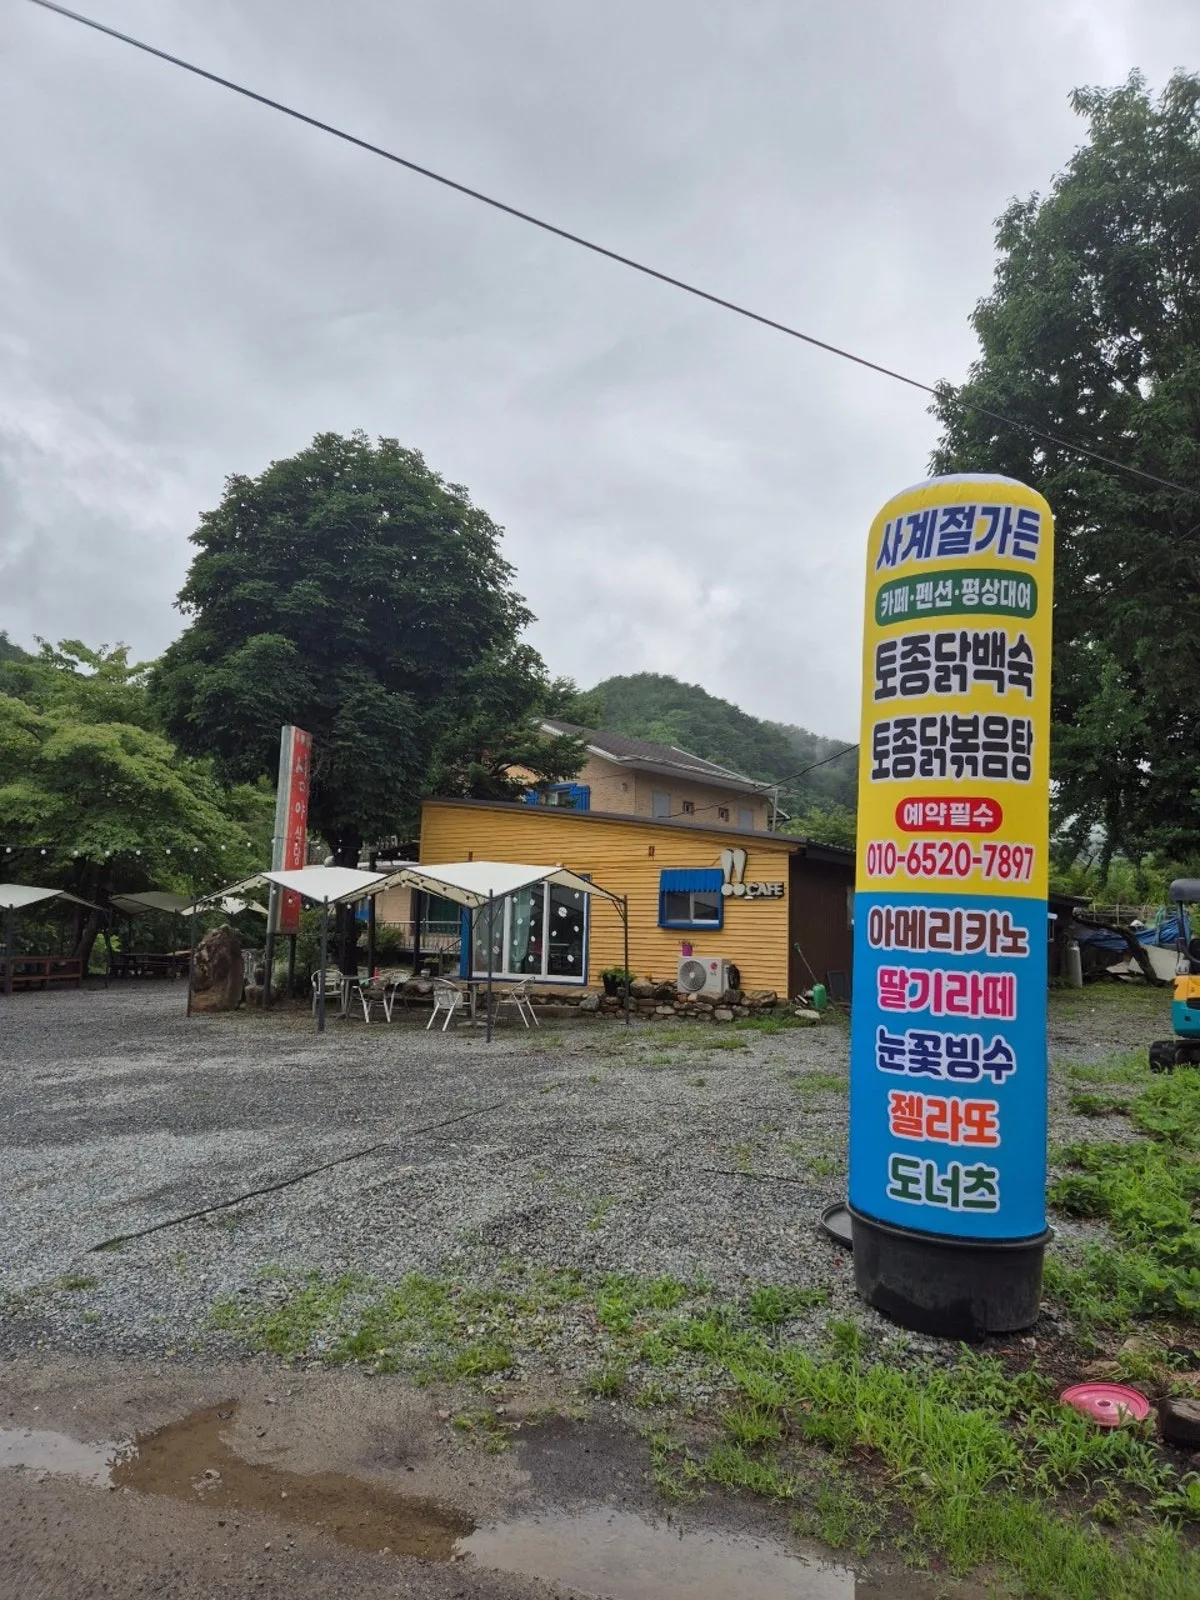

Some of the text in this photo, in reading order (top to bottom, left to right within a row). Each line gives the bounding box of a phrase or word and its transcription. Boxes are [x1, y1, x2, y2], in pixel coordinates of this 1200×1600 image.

[876, 505, 1041, 570] 사계절가든
[875, 631, 1034, 700] 토종닭백숙
[872, 714, 1034, 781] 토종닭볶음탕
[903, 802, 994, 827] 예약필수
[868, 842, 1034, 880] 010-6520-7897
[745, 883, 784, 897] CAFE
[869, 907, 1028, 955] 아메리카노
[879, 967, 1014, 1017] 딸기라떼
[878, 1029, 1014, 1081] 눈꽃빙수
[890, 1093, 998, 1144] 젤라또
[889, 1156, 997, 1210] 도너츠
